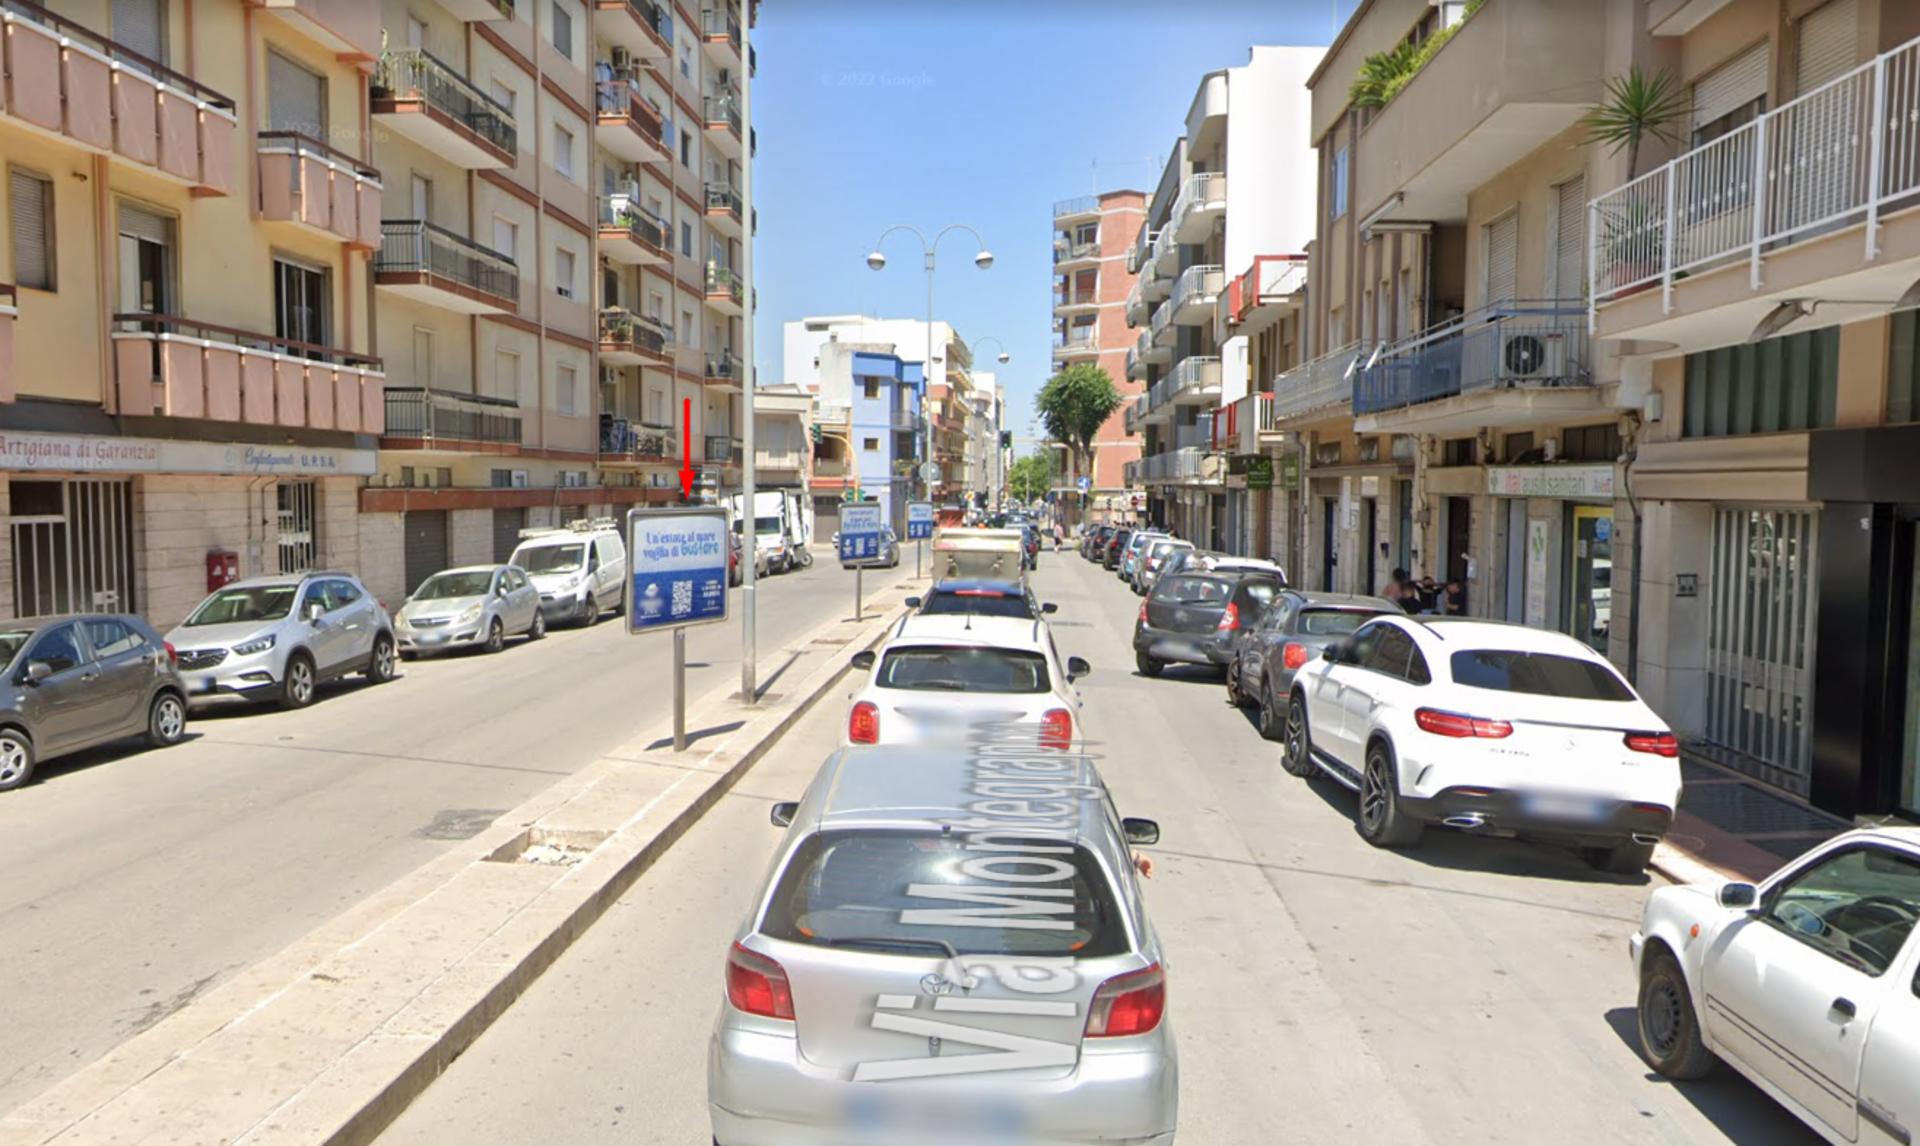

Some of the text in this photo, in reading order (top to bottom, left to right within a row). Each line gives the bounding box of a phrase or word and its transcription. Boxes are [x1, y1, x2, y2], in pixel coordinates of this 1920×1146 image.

[0, 434, 71, 465] Artigiana
[76, 440, 90, 458] di
[95, 440, 156, 460] Garanzia
[671, 545, 680, 557] di
